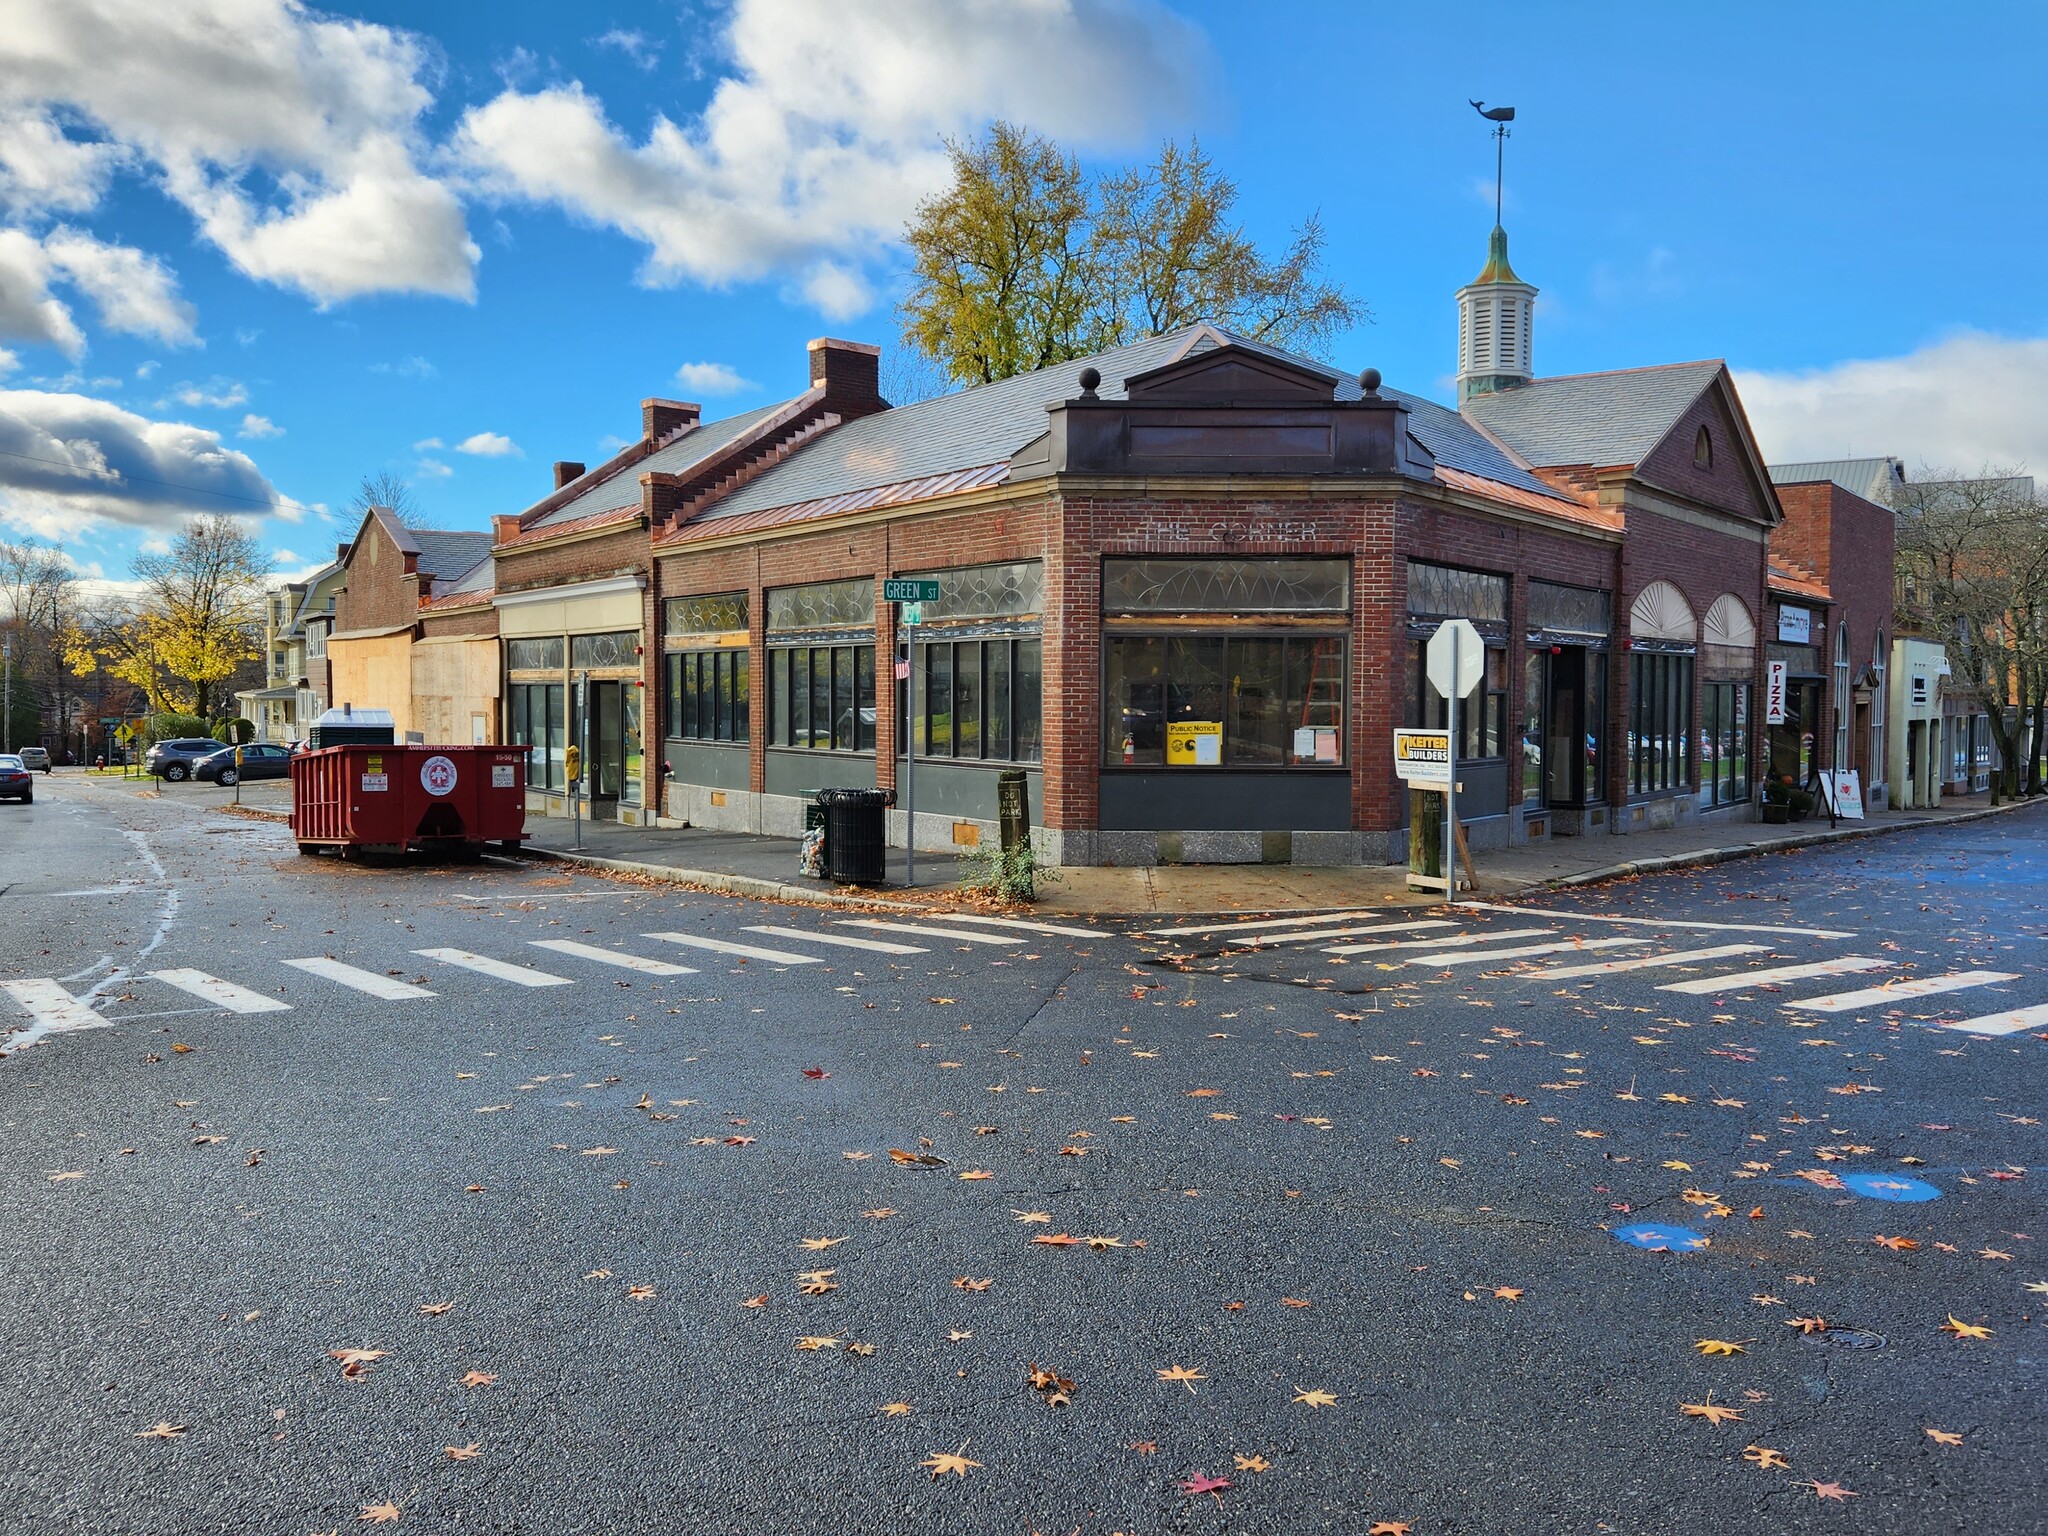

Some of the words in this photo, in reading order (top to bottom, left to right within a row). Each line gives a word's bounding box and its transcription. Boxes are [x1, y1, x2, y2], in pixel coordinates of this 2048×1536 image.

[1140, 522, 1190, 541] THE
[1208, 522, 1316, 541] CORNER
[886, 582, 920, 599] GREEN
[927, 587, 937, 599] ST
[1769, 664, 1782, 716] PIZZA
[1410, 736, 1448, 749] KEITER
[1410, 750, 1448, 761] BUILDERS
